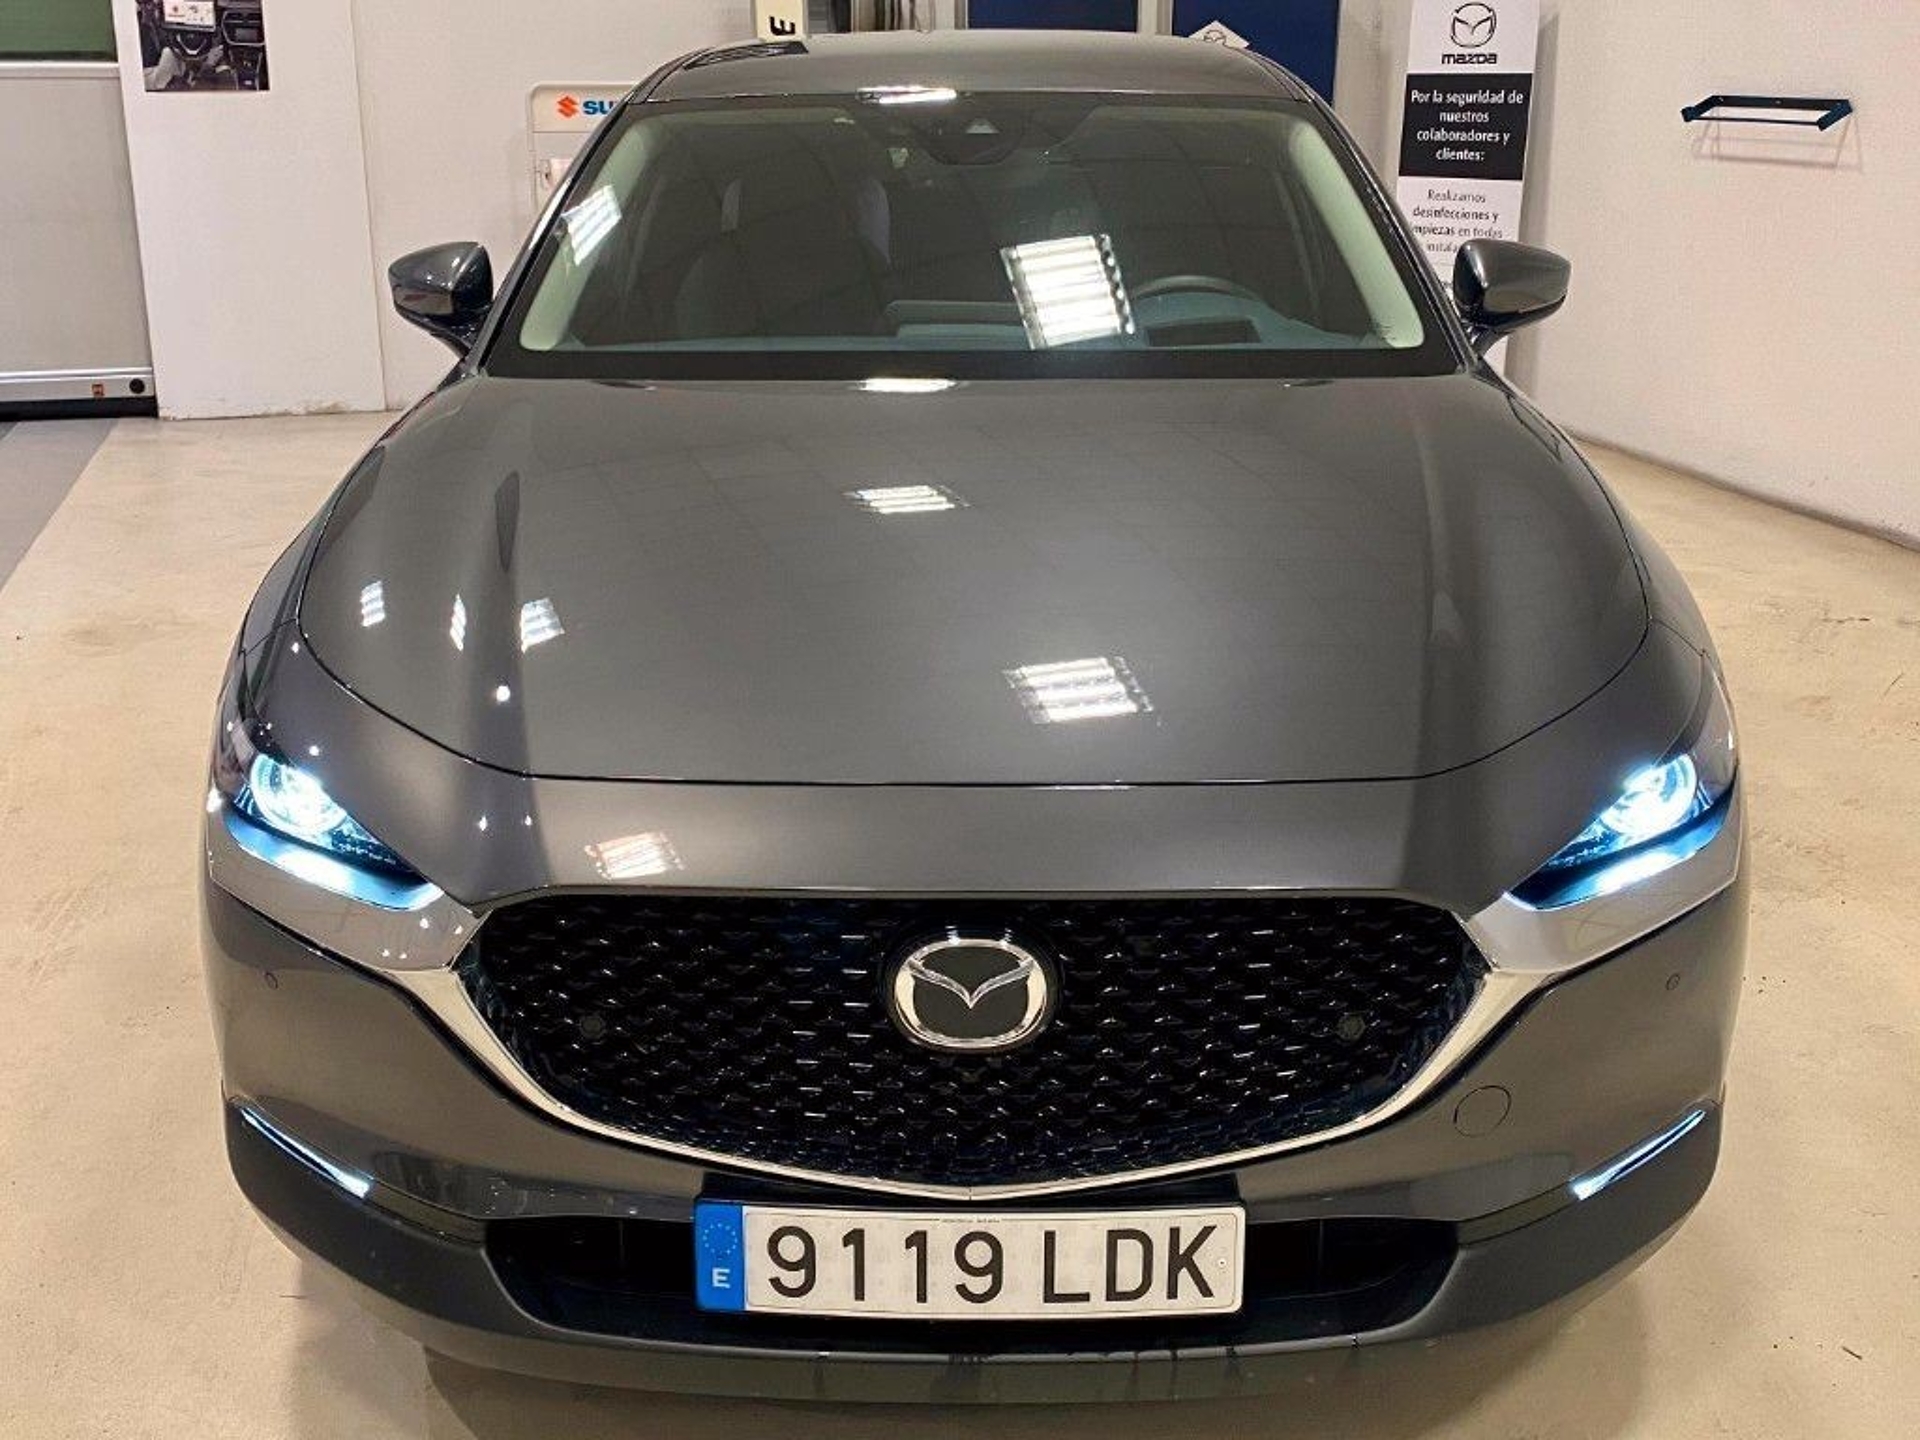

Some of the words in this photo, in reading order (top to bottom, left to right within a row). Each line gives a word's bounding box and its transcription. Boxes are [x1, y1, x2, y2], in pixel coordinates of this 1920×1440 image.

[1441, 53, 1498, 65] mazda
[1411, 89, 1431, 104] Por
[1432, 89, 1443, 104] la
[1446, 89, 1505, 107] seguridad
[1507, 90, 1524, 104] de
[582, 100, 615, 115] SU
[1440, 111, 1490, 123] nuestros
[1416, 127, 1501, 142] colaboradores
[1503, 132, 1511, 146] y
[1435, 147, 1486, 161] clientes:
[1427, 188, 1487, 204] Realizamos
[1413, 205, 1490, 220] desinfecciones
[1492, 212, 1500, 223] y
[1458, 228, 1471, 238] en
[1473, 227, 1504, 239] todas
[766, 1224, 1005, 1304] 9119
[1042, 1224, 1219, 1304] LDK
[711, 1267, 731, 1289] E
